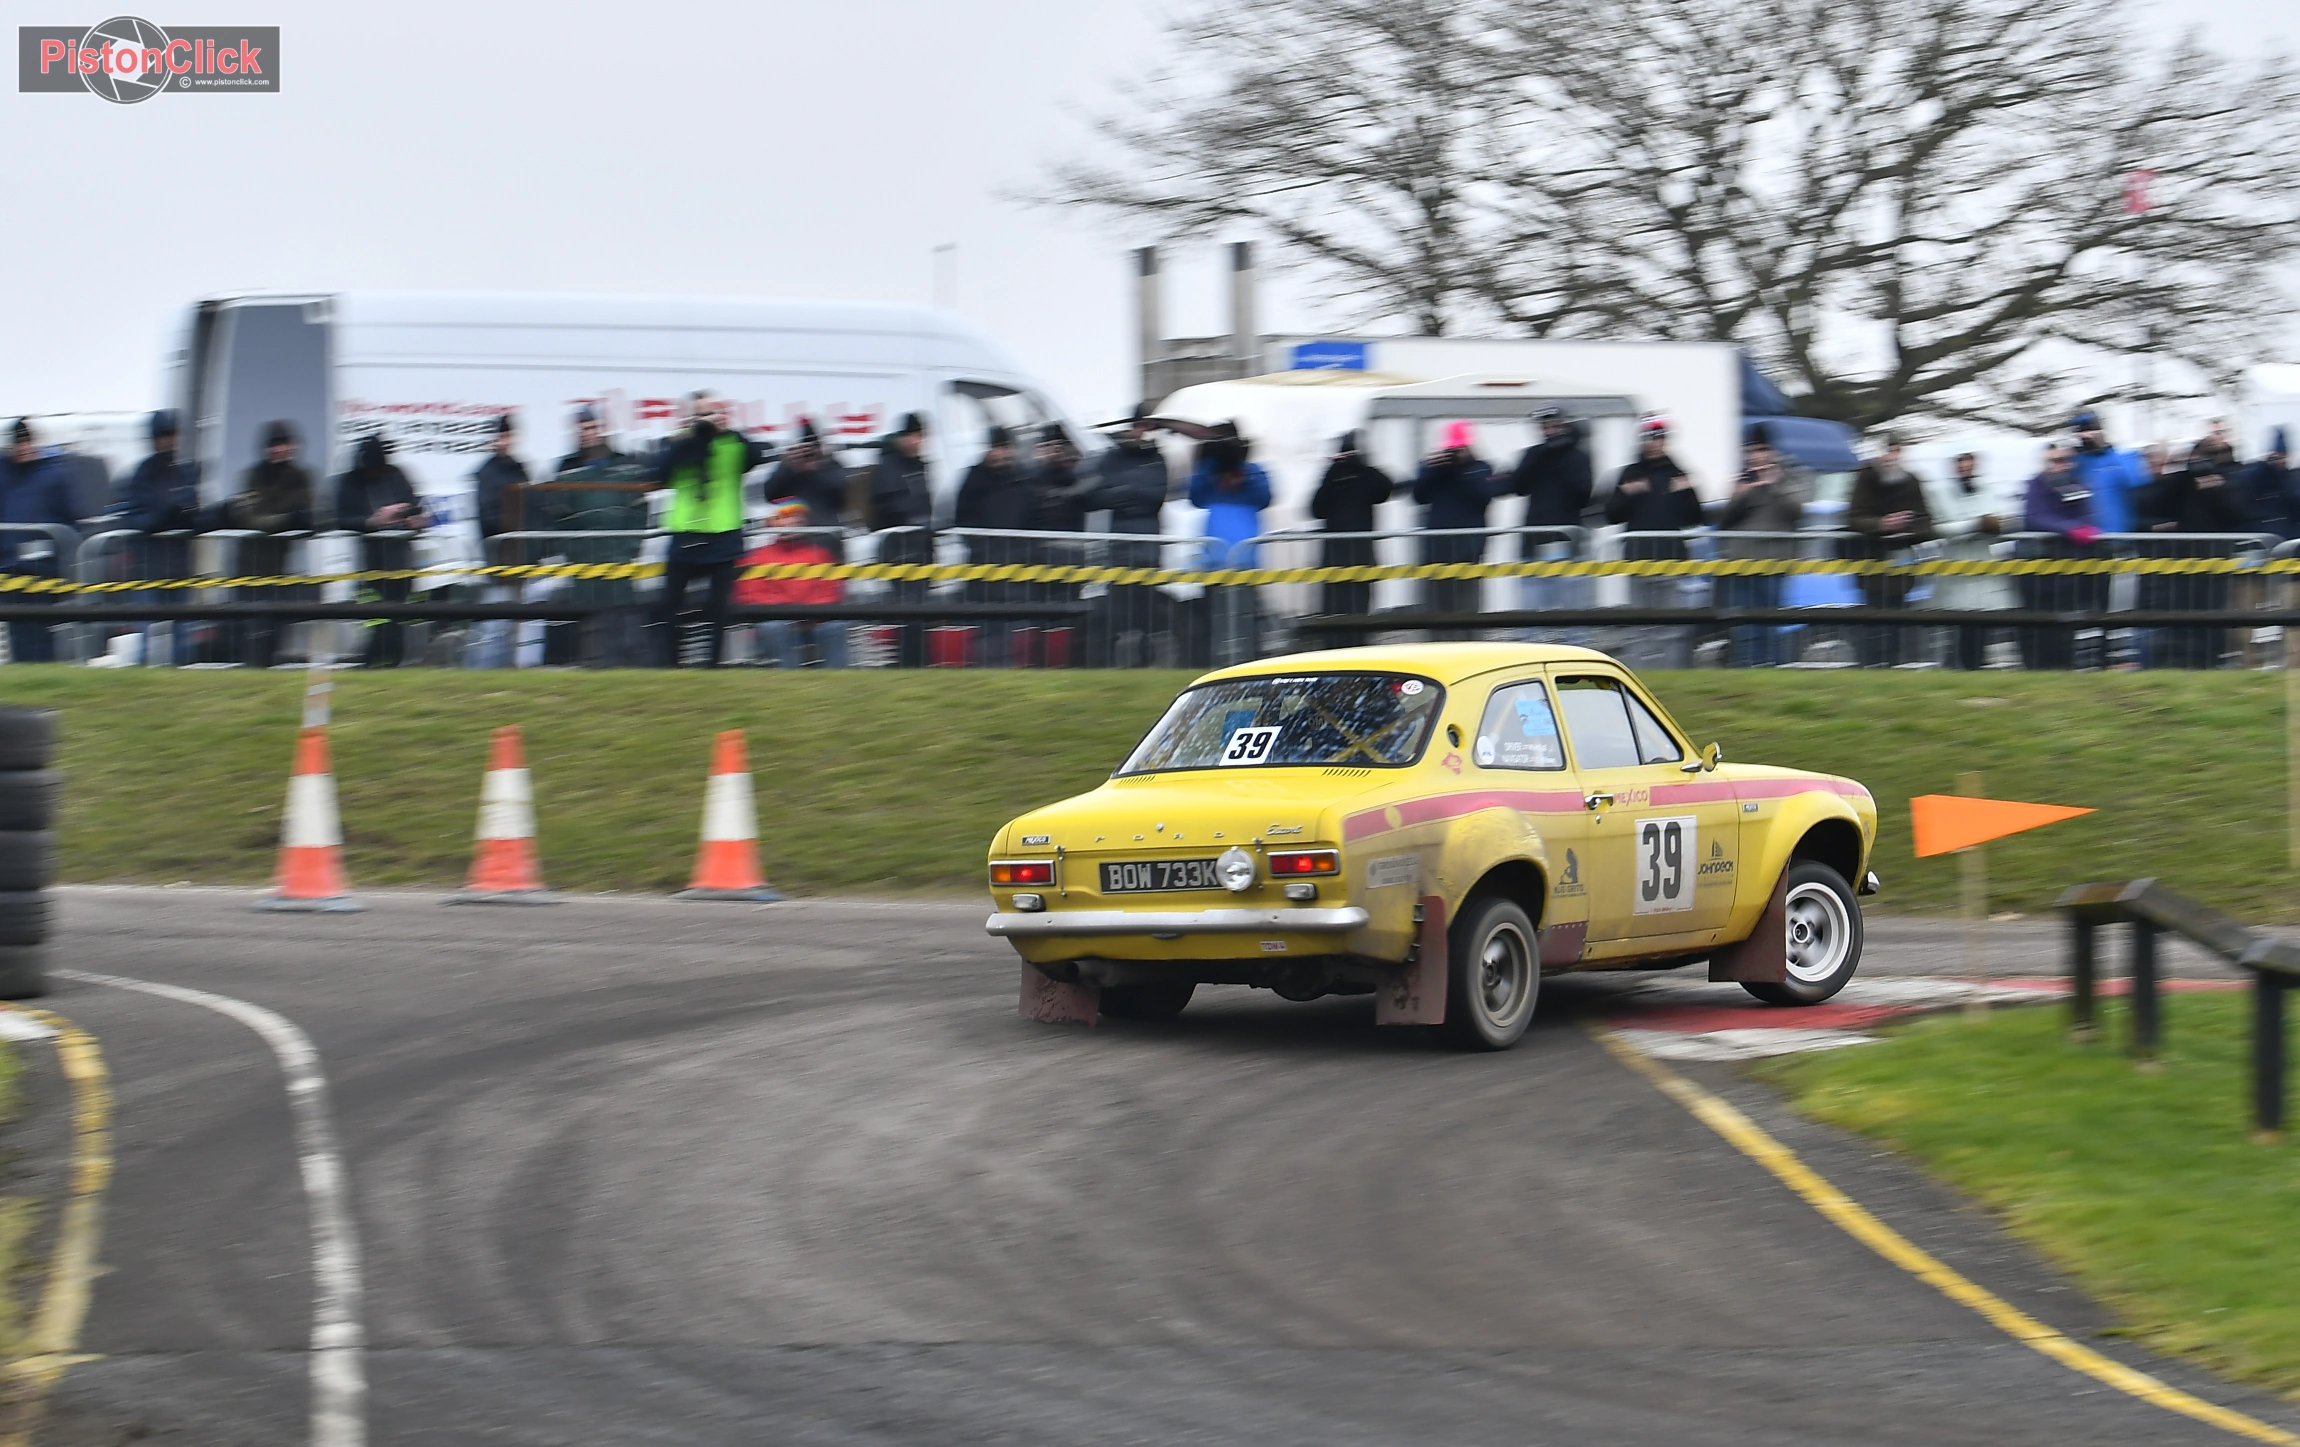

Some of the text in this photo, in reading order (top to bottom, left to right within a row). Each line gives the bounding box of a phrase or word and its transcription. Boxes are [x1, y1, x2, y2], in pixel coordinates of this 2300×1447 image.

[1228, 731, 1273, 760] 39
[1614, 789, 1648, 806] MEXICO
[1266, 823, 1303, 836] Escort
[1108, 861, 1219, 890] BOW 733K
[1641, 821, 1682, 902] 39
